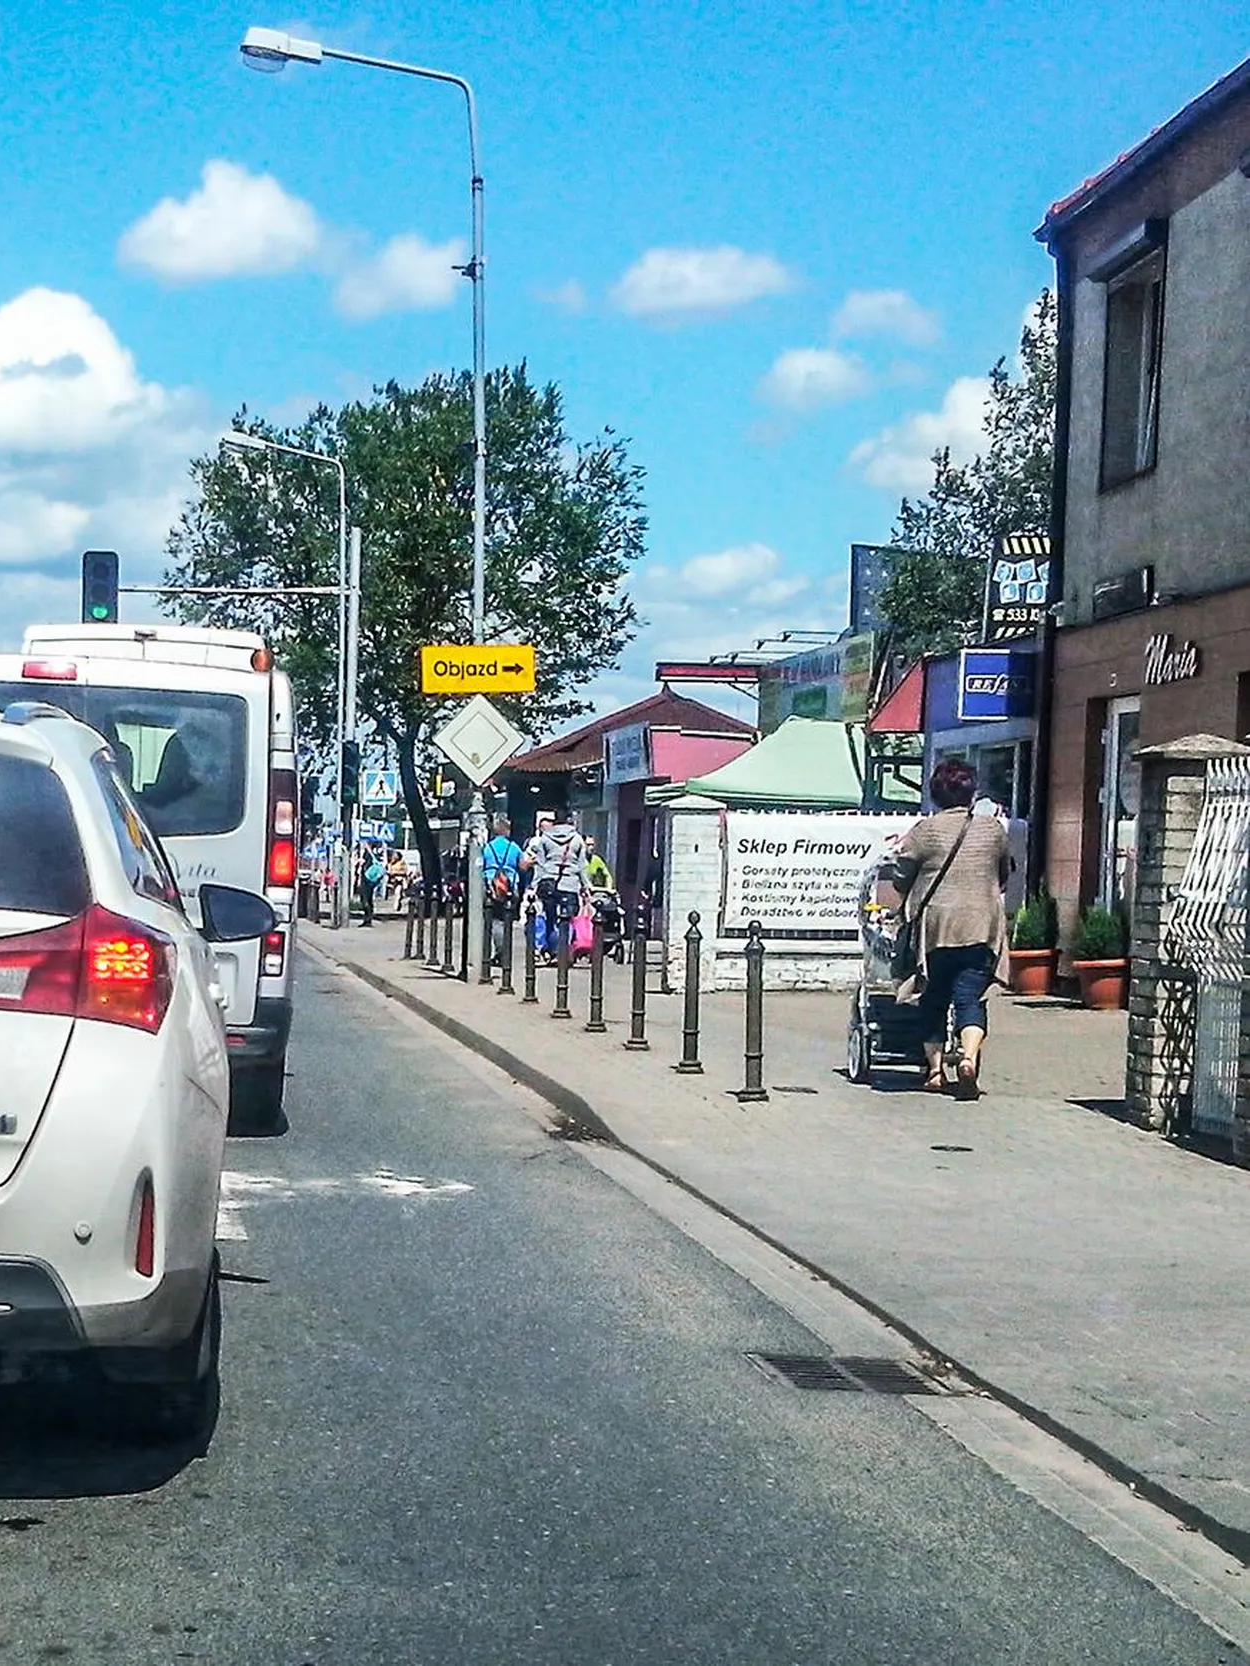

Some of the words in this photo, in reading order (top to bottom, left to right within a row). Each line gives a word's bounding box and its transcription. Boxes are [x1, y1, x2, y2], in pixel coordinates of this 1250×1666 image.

[433, 660, 498, 680] Objazd
[737, 838, 787, 857] Sklep
[793, 839, 872, 859] Firmowy
